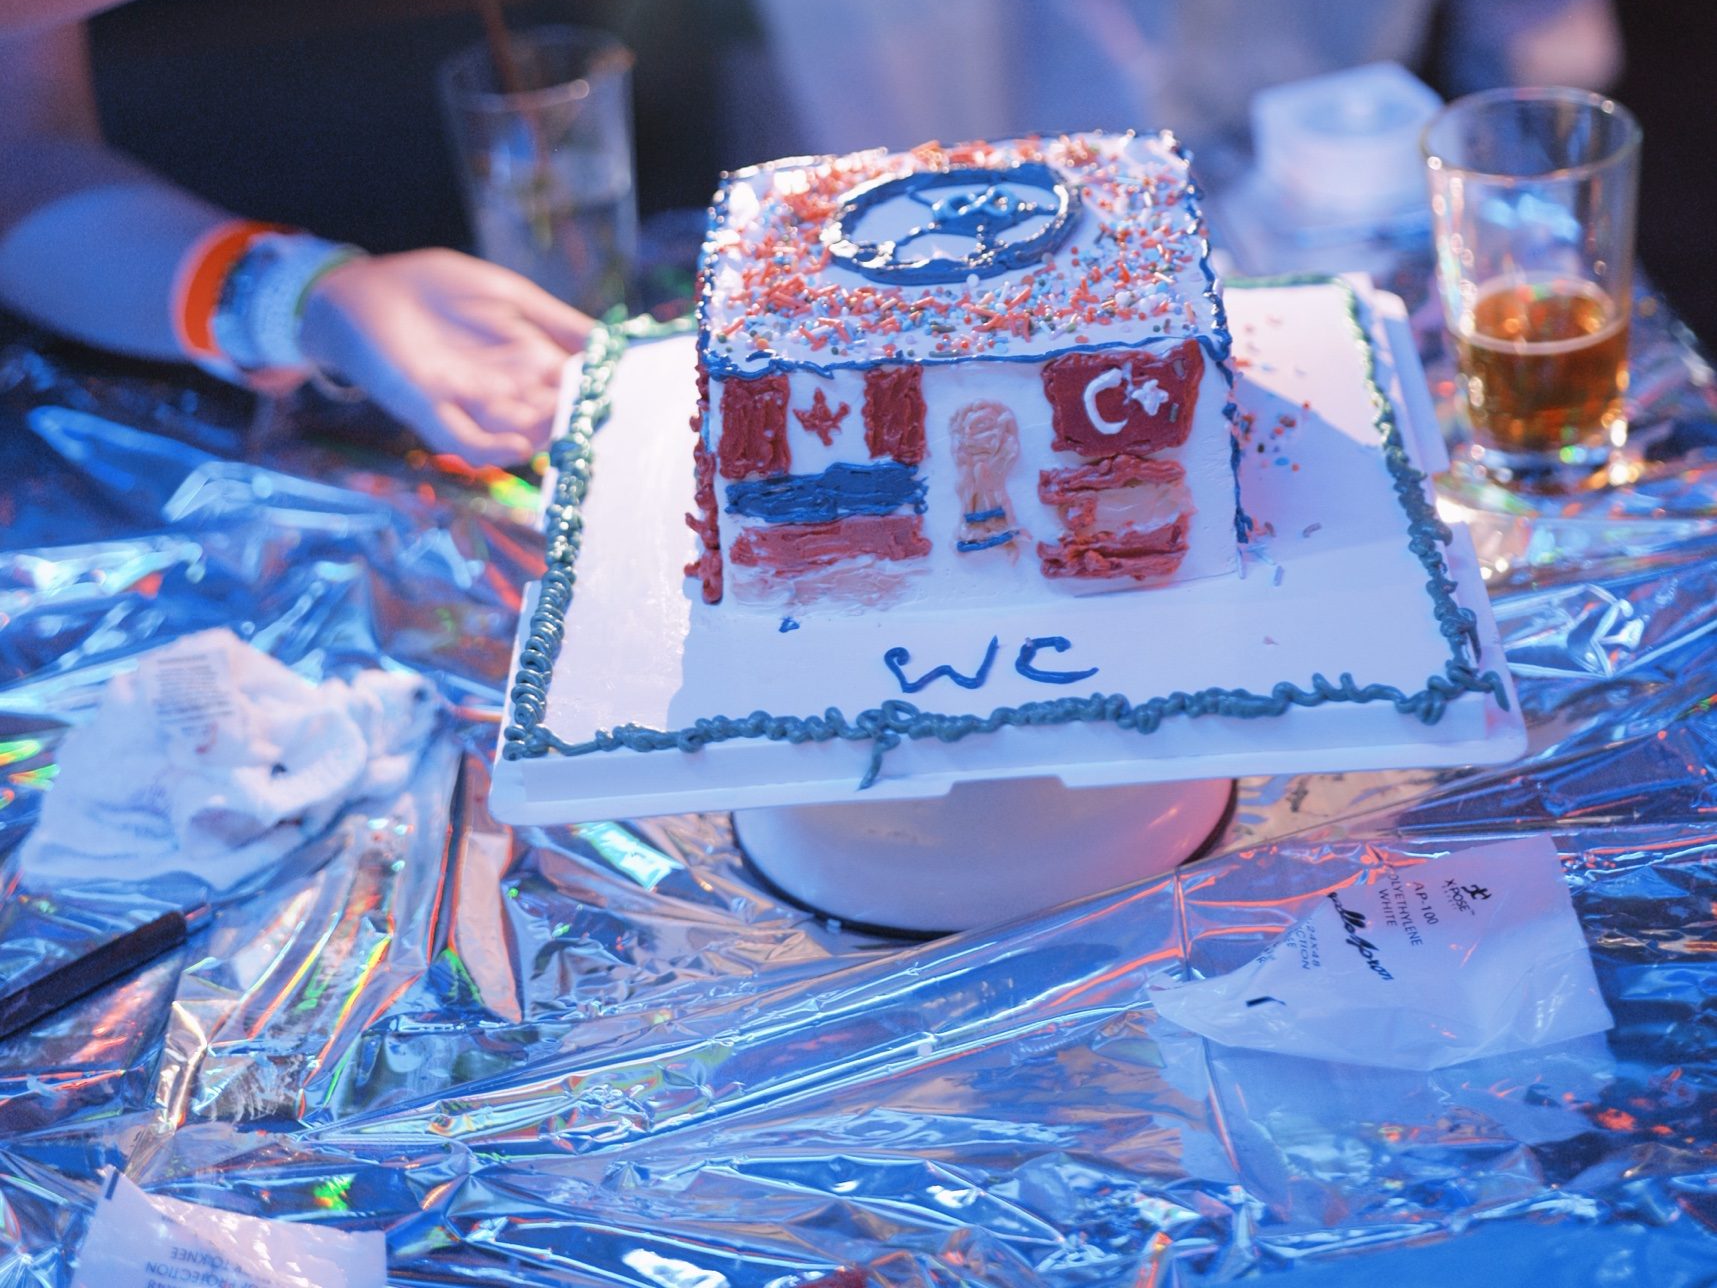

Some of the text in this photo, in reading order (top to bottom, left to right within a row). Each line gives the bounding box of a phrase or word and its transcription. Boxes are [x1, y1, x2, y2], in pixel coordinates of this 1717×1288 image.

[1379, 888, 1398, 927] WHITE
[1412, 881, 1439, 925] AP-100
[170, 1246, 210, 1266] KNEE
